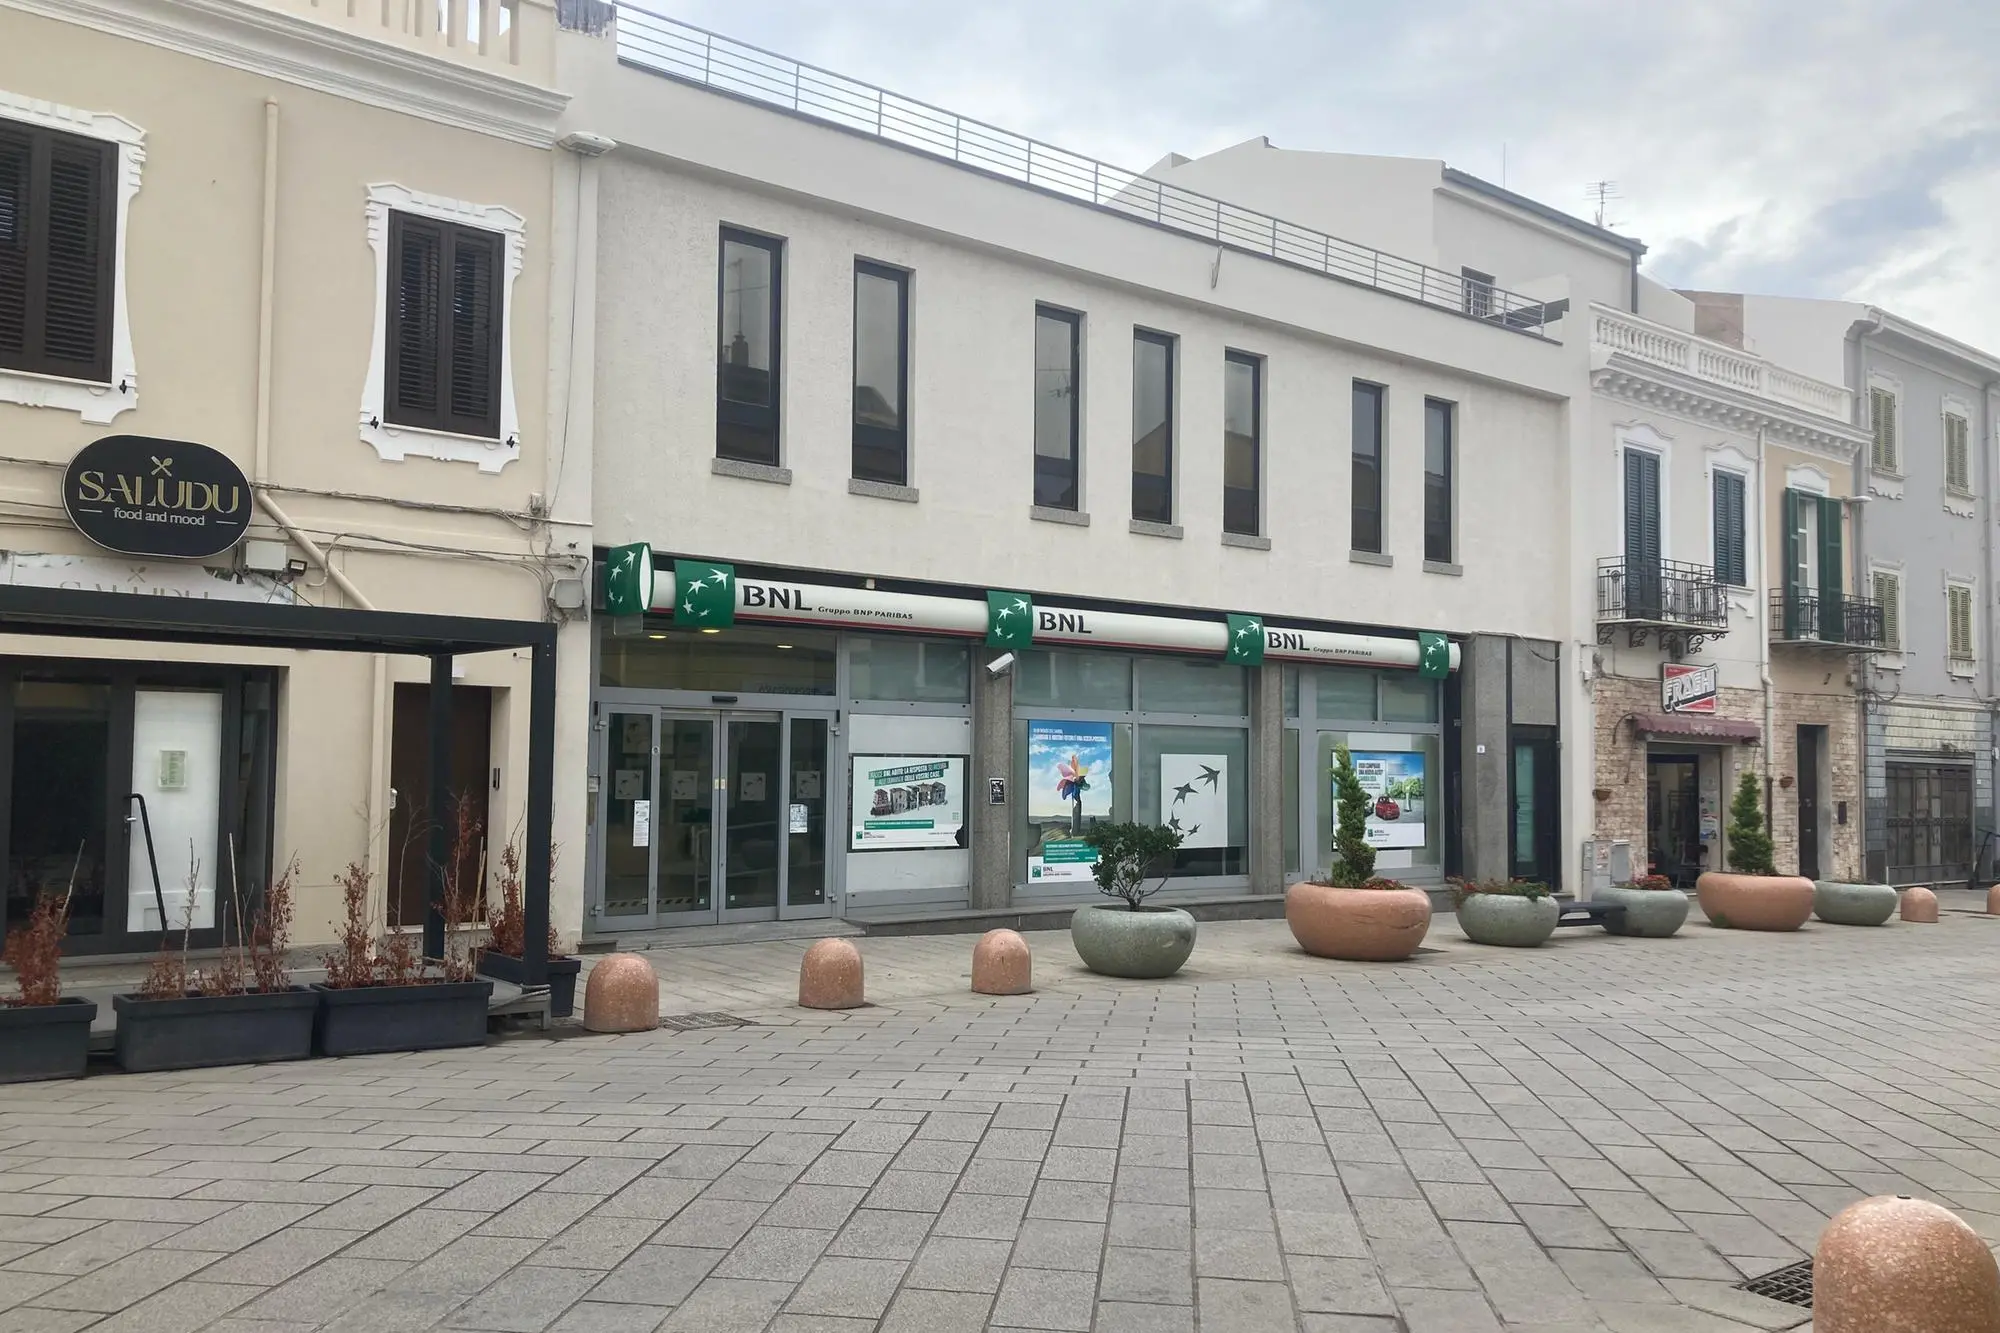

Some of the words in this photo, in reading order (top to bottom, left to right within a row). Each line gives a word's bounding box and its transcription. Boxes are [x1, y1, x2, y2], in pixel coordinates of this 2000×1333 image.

[79, 470, 239, 513] SALUDU
[113, 507, 143, 520] food
[145, 511, 167, 523] and
[169, 514, 205, 526] mood
[743, 585, 812, 611] BNL
[818, 606, 851, 615] Gruppo
[853, 608, 873, 616] BNP
[874, 610, 913, 620] PARIBAS
[1039, 611, 1092, 634] BNL
[1267, 631, 1310, 651] BNL
[1313, 646, 1333, 654] Gruppo
[1347, 649, 1373, 657] PARIBAS
